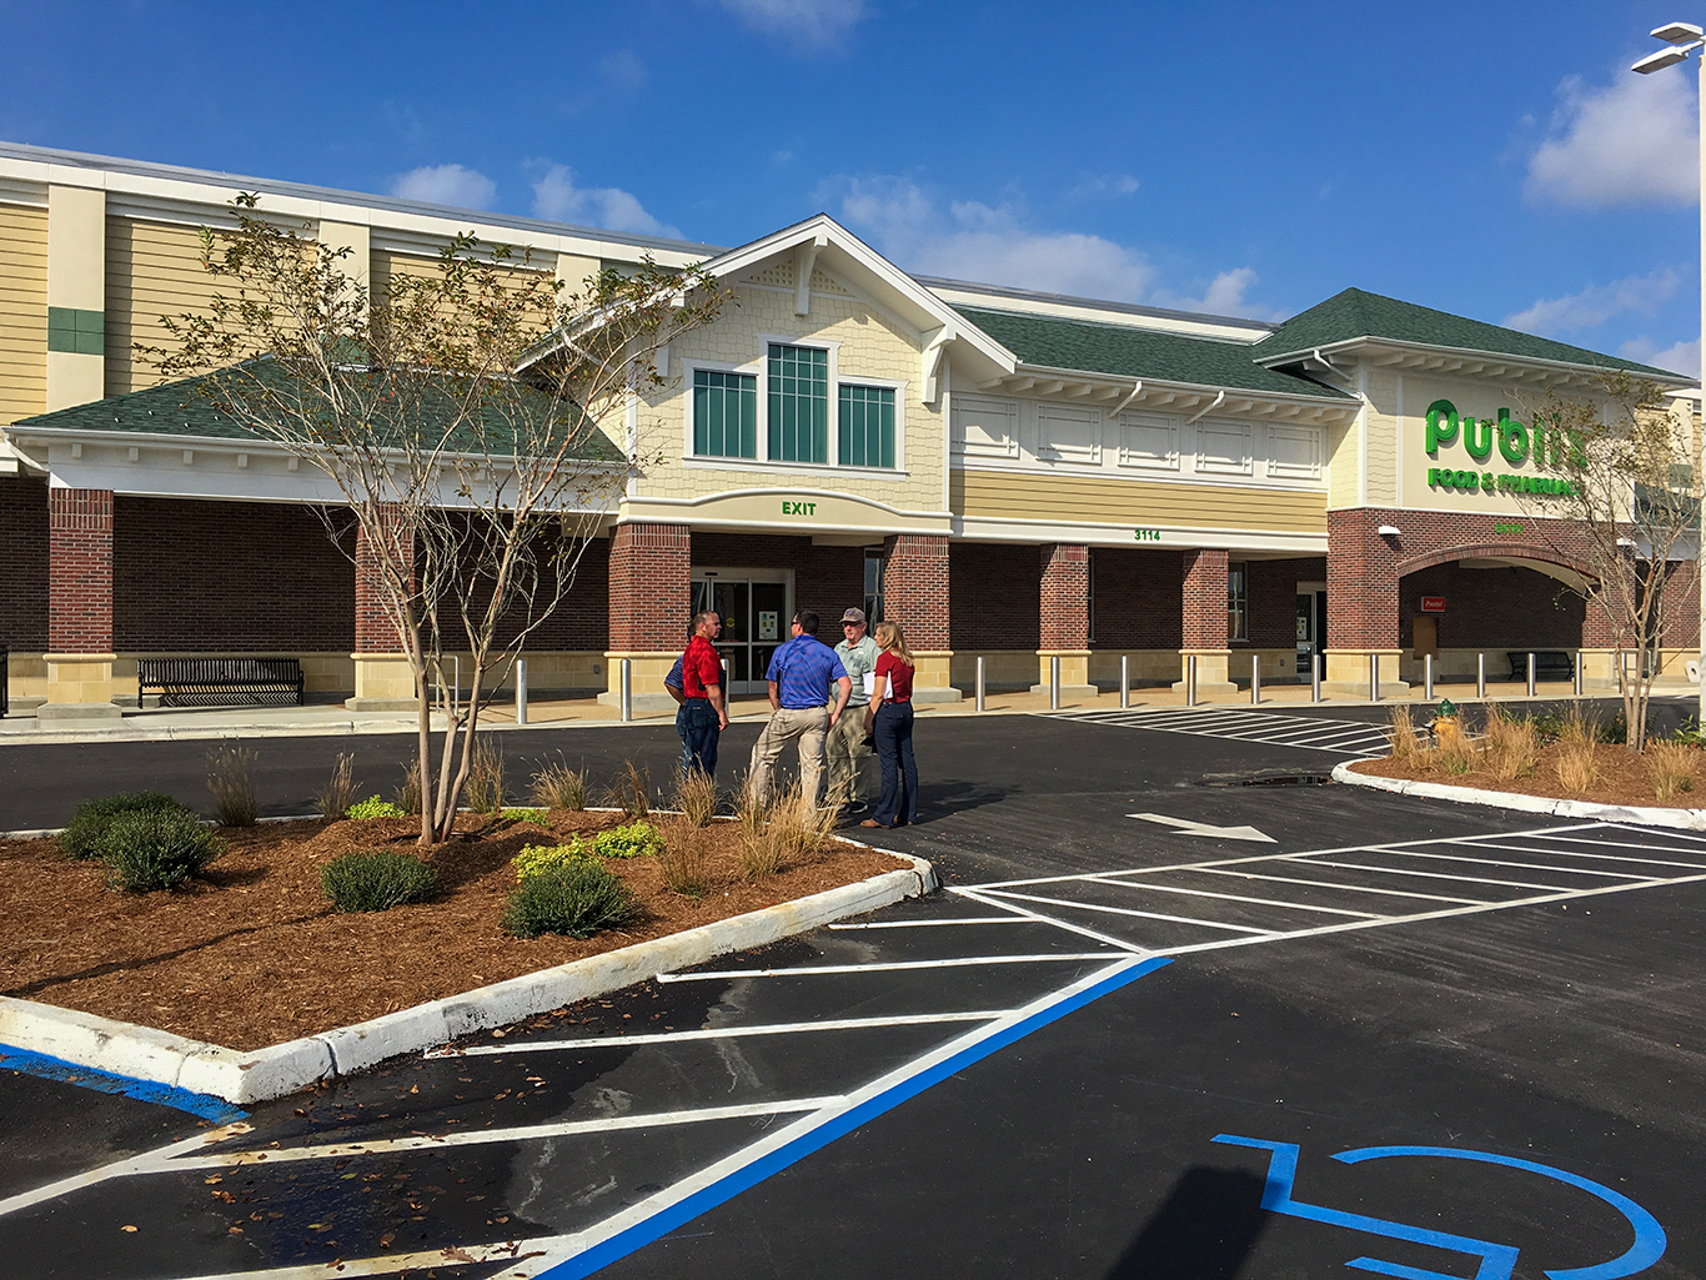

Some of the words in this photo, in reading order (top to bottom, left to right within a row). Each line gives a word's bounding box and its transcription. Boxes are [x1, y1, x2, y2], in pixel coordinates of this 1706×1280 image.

[1428, 468, 1479, 488] FOOD
[1481, 472, 1494, 491] &
[1497, 474, 1584, 497] PHARMA
[782, 501, 816, 515] EXIT
[1134, 529, 1160, 541] 3114
[1495, 523, 1524, 534] ENTRY
